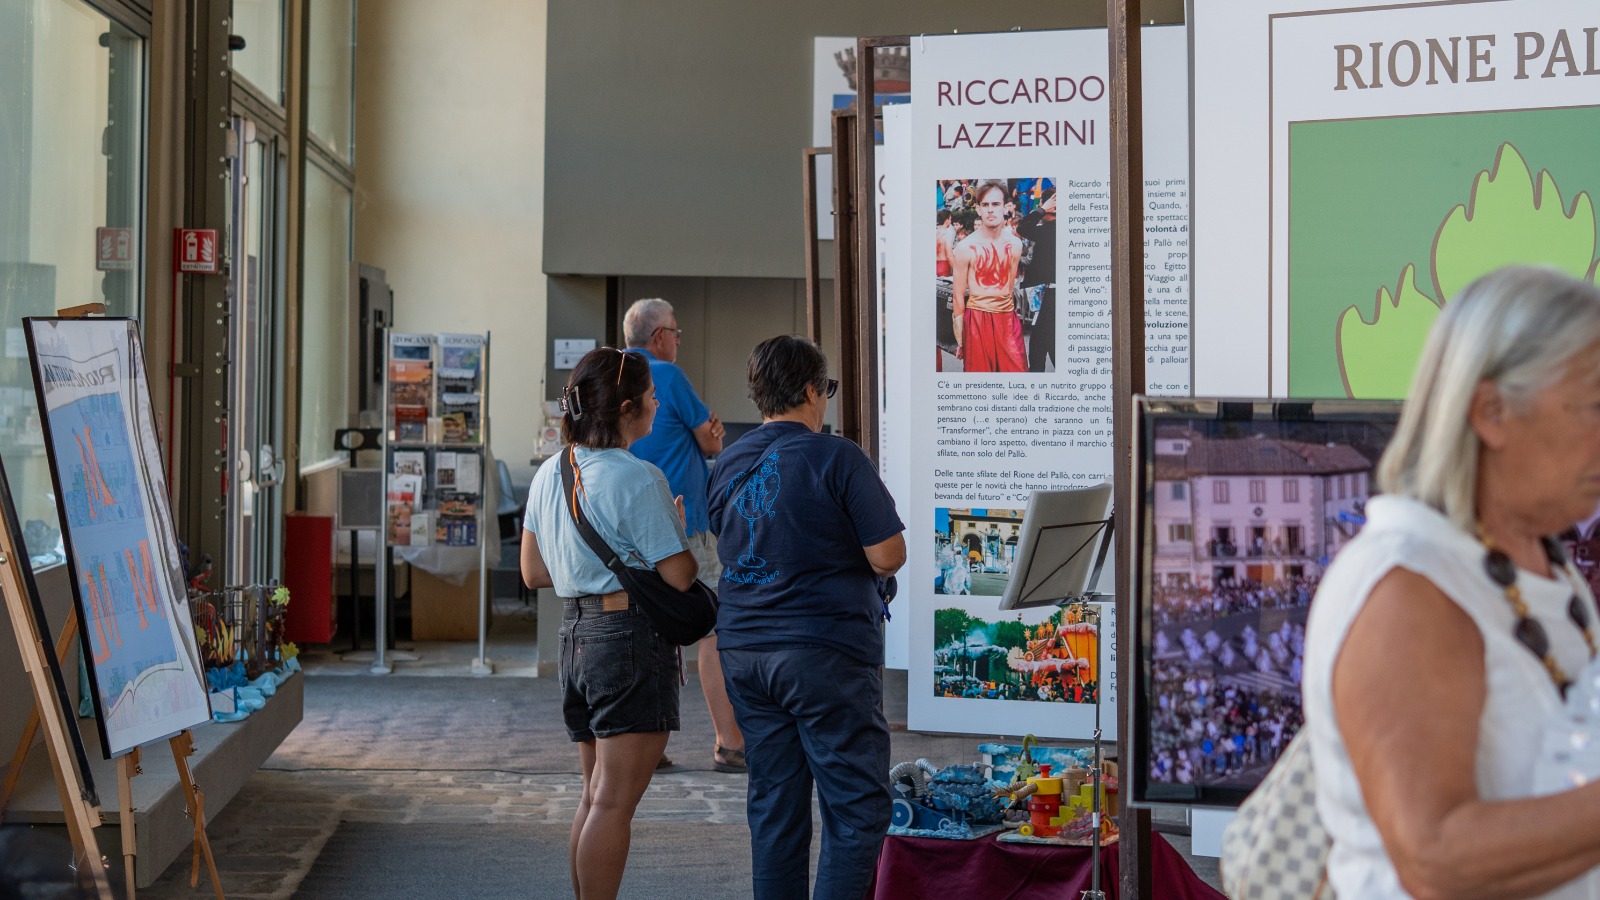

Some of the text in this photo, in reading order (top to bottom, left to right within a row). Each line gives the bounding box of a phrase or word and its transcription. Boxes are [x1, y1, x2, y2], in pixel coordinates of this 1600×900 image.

[1333, 26, 1600, 91] RIONE PAL
[937, 75, 1105, 107] RICCARDO
[937, 119, 1095, 149] LAZZERINI
[1068, 180, 1102, 188] Riccardo
[1144, 178, 1161, 186] suoi
[1165, 178, 1186, 188] primi
[1068, 191, 1110, 200] elementari,
[1147, 190, 1176, 198] insieme
[1068, 201, 1182, 211] della Festa Quando,
[1068, 214, 1108, 224] progettare
[1145, 224, 1178, 233] volontà
[1180, 224, 1188, 233] di
[1068, 240, 1100, 248] Arrivato
[1103, 239, 1110, 247] al
[1154, 238, 1172, 247] Pallò
[1164, 262, 1186, 272] Egitto
[1068, 275, 1101, 284] progetto
[1068, 286, 1080, 294] del
[1068, 298, 1108, 307] rimangono
[1068, 310, 1094, 319] tempio
[1097, 309, 1104, 317] di
[1155, 309, 1162, 317] le
[394, 335, 432, 344] TOSCANA
[444, 337, 482, 345] TOSCANA
[1068, 344, 1075, 352] di
[1077, 345, 1112, 354] passaggio
[1147, 356, 1154, 364] di
[1068, 367, 1089, 377] voglia
[1091, 367, 1098, 375] di
[965, 381, 1005, 391] presidente,
[1008, 381, 1027, 390] Luca,
[1050, 382, 1077, 390] nutrito
[1079, 383, 1107, 391] gruppo
[1149, 382, 1163, 390] che
[1013, 393, 1028, 401] idee
[1033, 393, 1040, 401] di
[1045, 393, 1080, 401] Riccardo,
[937, 404, 973, 412] sembrano
[991, 404, 1018, 412] distanti
[1019, 404, 1036, 412] dalla
[1038, 405, 1074, 413] tradizione
[995, 415, 1028, 425] sperano)
[1034, 416, 1048, 424] che
[994, 427, 1008, 435] che
[1042, 427, 1049, 435] in
[1052, 428, 1074, 437] piazza
[937, 438, 971, 446] cambiano
[973, 438, 978, 446] il
[999, 440, 1028, 448] aspetto,
[1031, 439, 1067, 447] diventano
[1069, 439, 1074, 447] il
[1076, 439, 1108, 447] marchio
[937, 449, 959, 458] sfilate,
[977, 450, 993, 458] solo
[994, 450, 1006, 458] del
[1007, 450, 1027, 458] Pallò.
[934, 469, 954, 477] Delle
[976, 470, 998, 478] sfilate
[999, 470, 1011, 478] del
[1013, 470, 1035, 479] Rione
[1036, 471, 1048, 479] del
[934, 482, 958, 492] queste
[960, 483, 973, 493] per
[975, 481, 982, 489] le
[984, 482, 1007, 490] novità
[1009, 482, 1023, 490] che
[1025, 482, 1048, 490] hanno
[934, 492, 963, 500] bevanda
[965, 492, 976, 500] del
